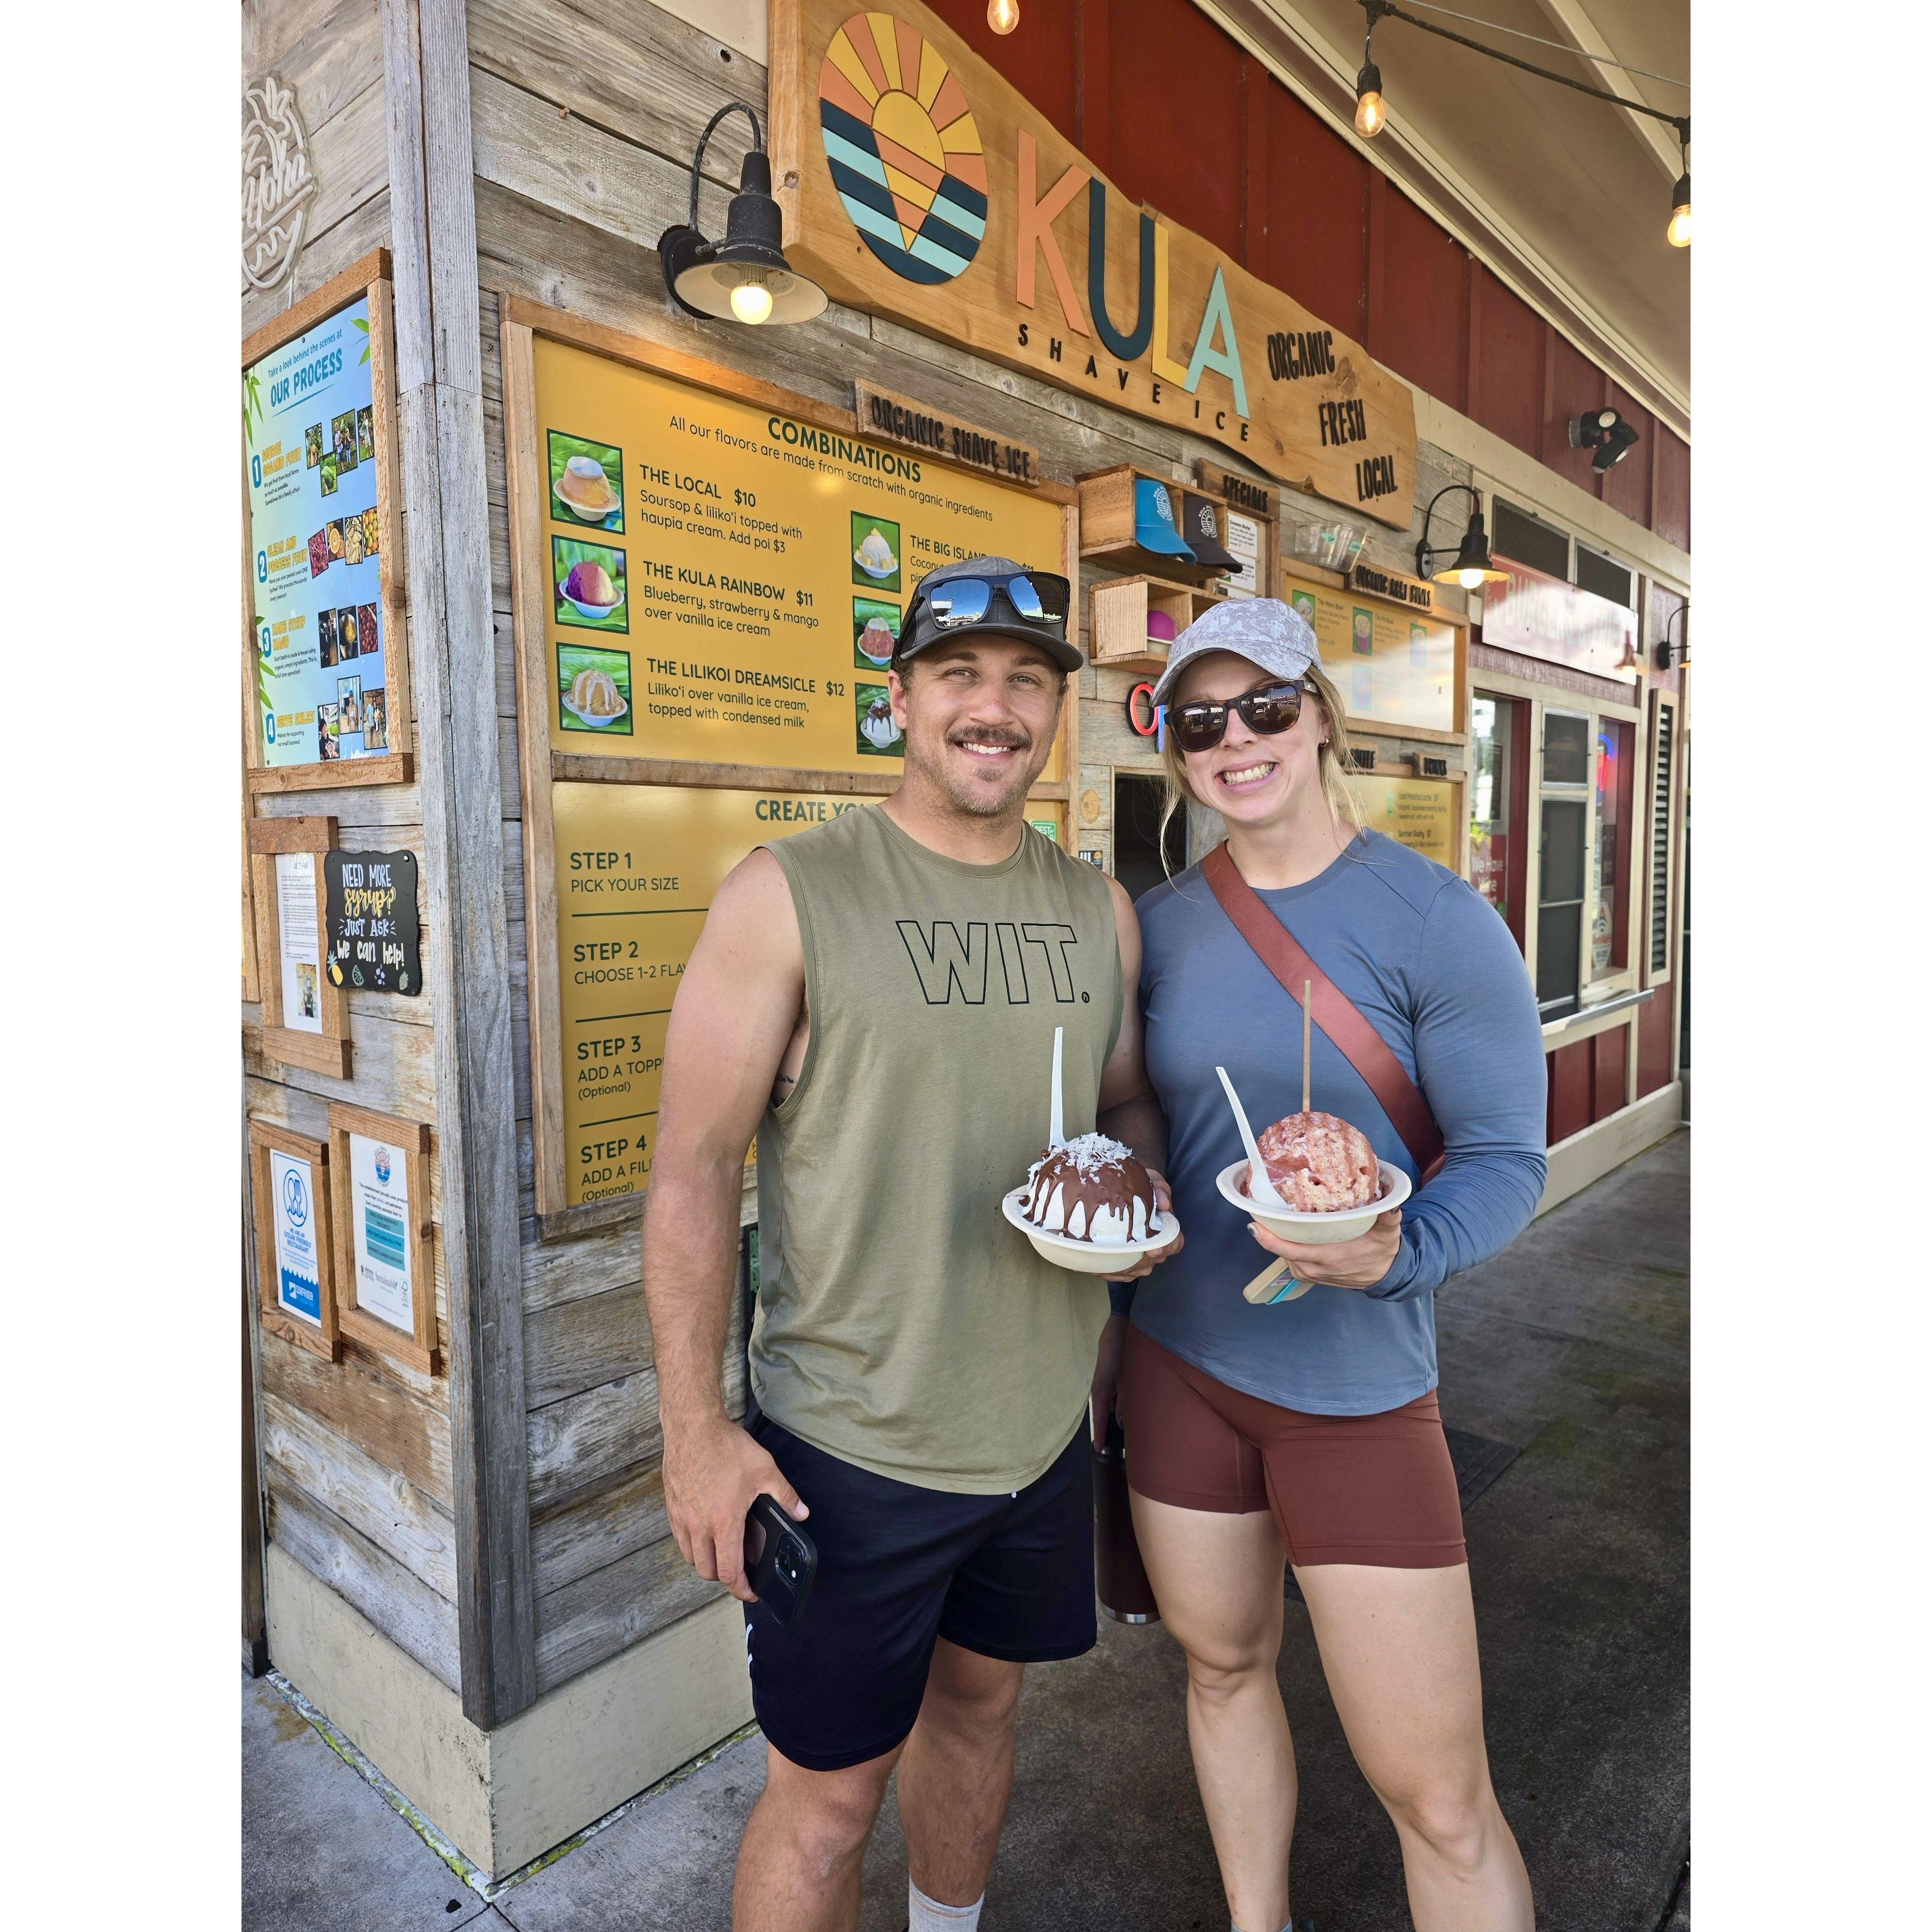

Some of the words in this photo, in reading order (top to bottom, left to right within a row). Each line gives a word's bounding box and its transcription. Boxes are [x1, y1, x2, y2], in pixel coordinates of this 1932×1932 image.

[1016, 128, 1249, 419] KULA
[268, 367, 278, 379] Take
[282, 357, 293, 370] look
[293, 346, 309, 364] behind
[310, 343, 318, 355] the
[319, 333, 336, 349] scenes
[336, 329, 342, 340] at
[1267, 330, 1335, 382] ORGANIC
[270, 377, 290, 408] OUR
[293, 348, 342, 396] PROCESS
[1018, 324, 1160, 404] SHAVE
[1194, 399, 1249, 443] ICE
[871, 395, 945, 449] ORGANIC
[952, 427, 998, 469] SHAVE
[1005, 444, 1030, 478] ICE
[1318, 399, 1366, 447] FRESH
[263, 455, 284, 477] ORGANIC
[285, 447, 301, 466] FRUIT
[768, 417, 921, 483] COMBINATIONS
[669, 415, 685, 432] All
[690, 424, 711, 439] our
[714, 428, 757, 453] flavors
[761, 445, 780, 459] are
[783, 452, 815, 469] made
[818, 459, 844, 478] from
[847, 471, 883, 490] scratch
[886, 482, 906, 497] with
[909, 489, 943, 507] organic
[945, 497, 993, 522] ingredients
[1355, 455, 1398, 501] LOCAL
[639, 464, 670, 486] THE
[675, 473, 722, 499] LOCAL
[734, 488, 756, 508] $10
[1222, 474, 1268, 513] SPECIALS
[640, 489, 691, 515] Soursop
[694, 503, 703, 516] &
[739, 514, 778, 534] topped
[781, 526, 802, 540] with
[641, 508, 682, 530] haupia
[686, 523, 725, 540] cream.
[728, 530, 751, 545] Add
[754, 538, 770, 550] poi
[773, 539, 785, 554] $3
[259, 555, 265, 577] 2
[285, 536, 297, 551] AND
[292, 548, 307, 566] FRUIT
[909, 535, 931, 552] THE
[934, 541, 951, 556] BIG
[953, 546, 986, 560] ISLAN
[643, 560, 673, 581] THE
[678, 568, 717, 589] KULA
[721, 575, 785, 601] RAINBOW
[796, 589, 813, 607] $11
[1356, 565, 1388, 594] ORGANIC
[1410, 585, 1431, 607] BOWLS
[644, 585, 706, 610] Blueberry,
[709, 598, 770, 622] strawberry
[773, 609, 781, 621] &
[783, 613, 819, 629] mango
[645, 607, 672, 620] over
[676, 612, 714, 627] vanilla
[717, 617, 733, 630] ice
[736, 623, 770, 637] cream
[264, 631, 270, 652] 3
[646, 658, 677, 676] THE
[682, 662, 730, 682] LILIKOI
[735, 669, 816, 693] DREAMSICLE
[826, 681, 845, 697] $12
[648, 702, 692, 719] topped
[695, 707, 719, 720] with
[722, 710, 781, 726] condensed
[784, 716, 805, 728] milk
[688, 689, 714, 701] over
[717, 692, 753, 706] vanilla
[756, 695, 771, 708] ice
[774, 699, 809, 713] cream,
[269, 718, 274, 738] 4
[755, 799, 826, 822] CREATE
[831, 802, 866, 818] YO
[342, 864, 364, 888] NEED
[369, 865, 391, 888] MORE
[570, 852, 619, 870] STEP
[624, 852, 631, 869] 1
[571, 879, 604, 893] PICK
[607, 878, 647, 892] YOUR
[651, 877, 679, 891] SIZE
[344, 887, 396, 917] syrup?
[344, 919, 365, 937] JUST
[370, 919, 389, 937] ASK
[357, 942, 376, 962] can
[383, 943, 404, 970] help!
[574, 942, 622, 962] STEP
[628, 941, 639, 958] 2
[574, 967, 634, 985] CHOOSE
[637, 966, 656, 979] 1-2
[577, 1037, 625, 1060] STEP
[631, 1035, 641, 1053] 3
[578, 1066, 609, 1083] ADD
[613, 1064, 623, 1078] A
[626, 1057, 664, 1075] TOPP
[578, 1081, 631, 1101] (Optional)
[581, 1138, 628, 1164] STEP
[635, 1135, 647, 1151] 4
[581, 1167, 612, 1187] ADD
[616, 1165, 626, 1179] A
[582, 1181, 634, 1203] (Optional)
